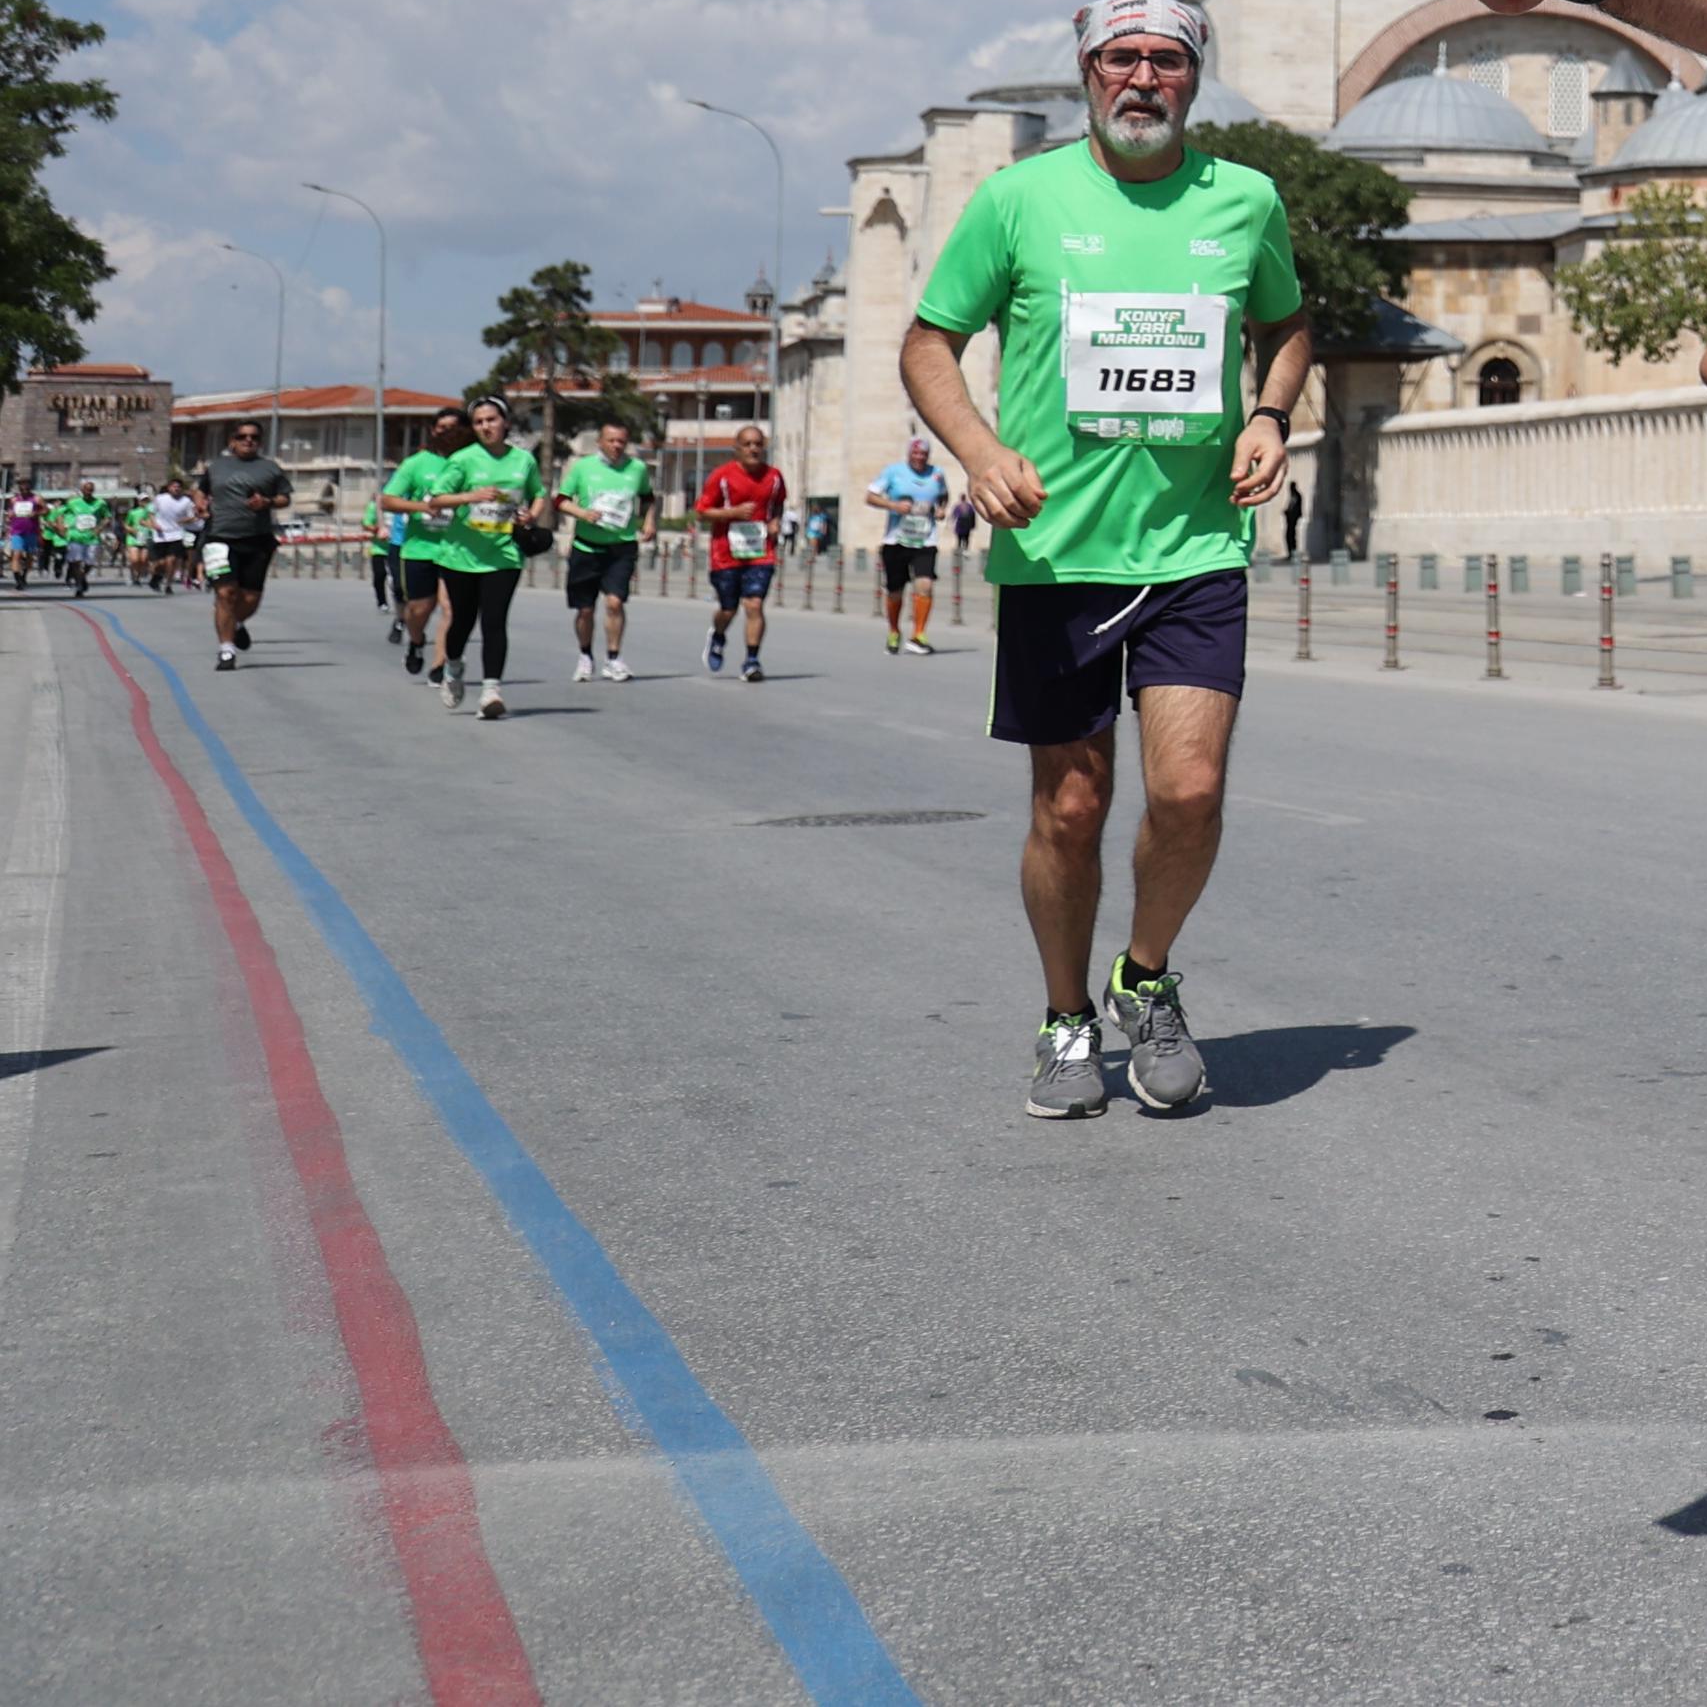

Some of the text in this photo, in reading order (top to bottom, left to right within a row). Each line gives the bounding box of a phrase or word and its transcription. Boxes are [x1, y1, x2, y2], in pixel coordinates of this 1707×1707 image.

[1118, 311, 1182, 324] KONYA
[1129, 322, 1171, 333] YARI
[1097, 333, 1200, 346] MARATONU
[1099, 368, 1196, 392] 11683
